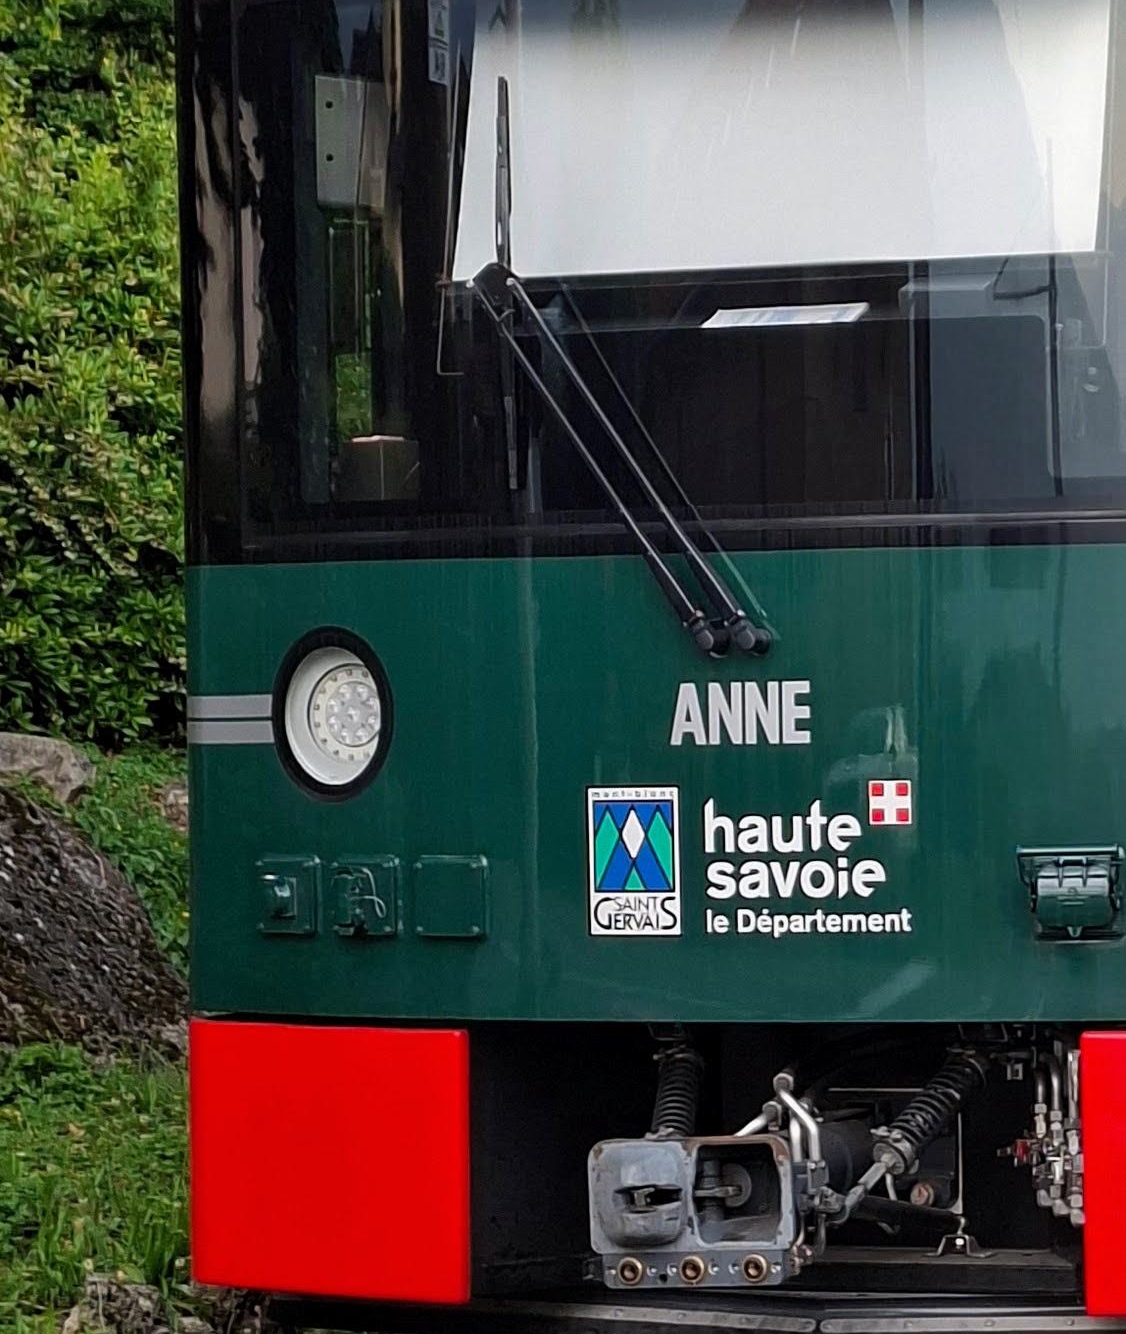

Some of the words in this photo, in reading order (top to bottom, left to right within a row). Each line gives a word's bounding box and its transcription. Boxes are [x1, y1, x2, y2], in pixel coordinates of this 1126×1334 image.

[670, 680, 811, 746] ANNE
[704, 798, 862, 853] haute
[706, 857, 886, 899] savoie
[594, 896, 677, 931] GERVAIS
[613, 896, 659, 912] SAINT
[706, 908, 729, 933] le
[737, 908, 912, 938] Département
